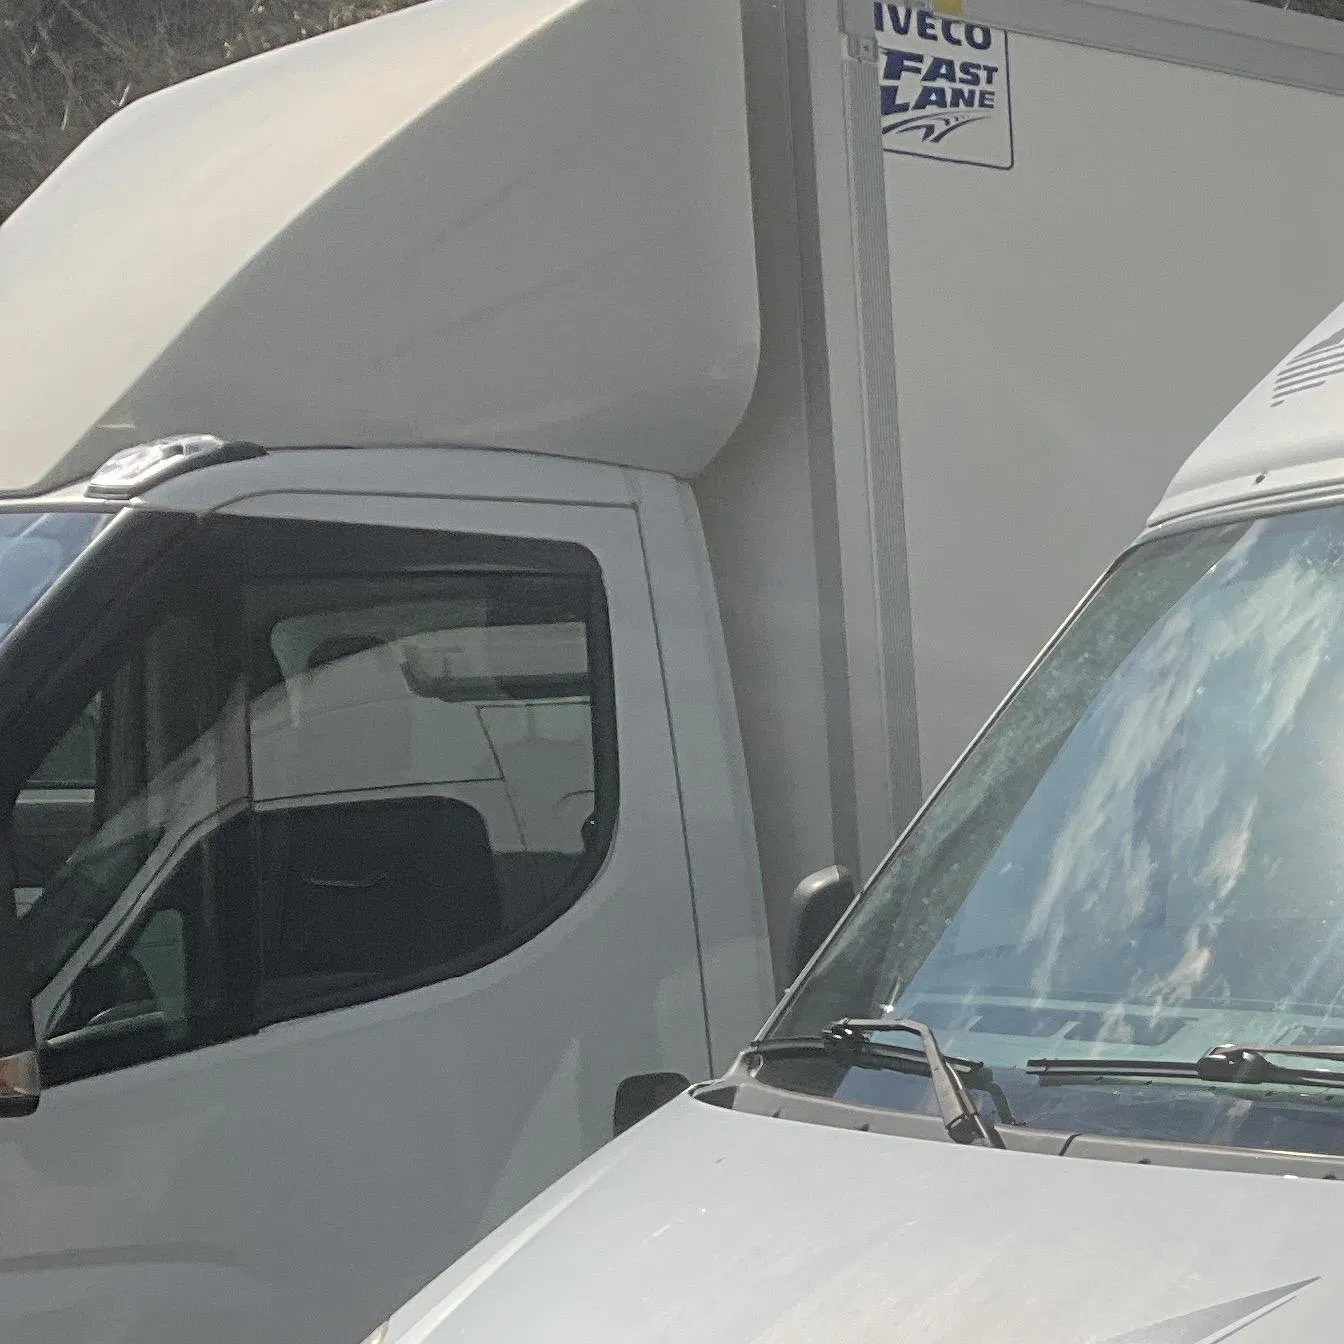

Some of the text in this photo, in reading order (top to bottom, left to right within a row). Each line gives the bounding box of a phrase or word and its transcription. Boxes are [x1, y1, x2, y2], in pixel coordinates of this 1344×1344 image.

[873, 1, 992, 50] IVECO
[881, 48, 998, 86] FAST
[880, 85, 995, 115] LANE
